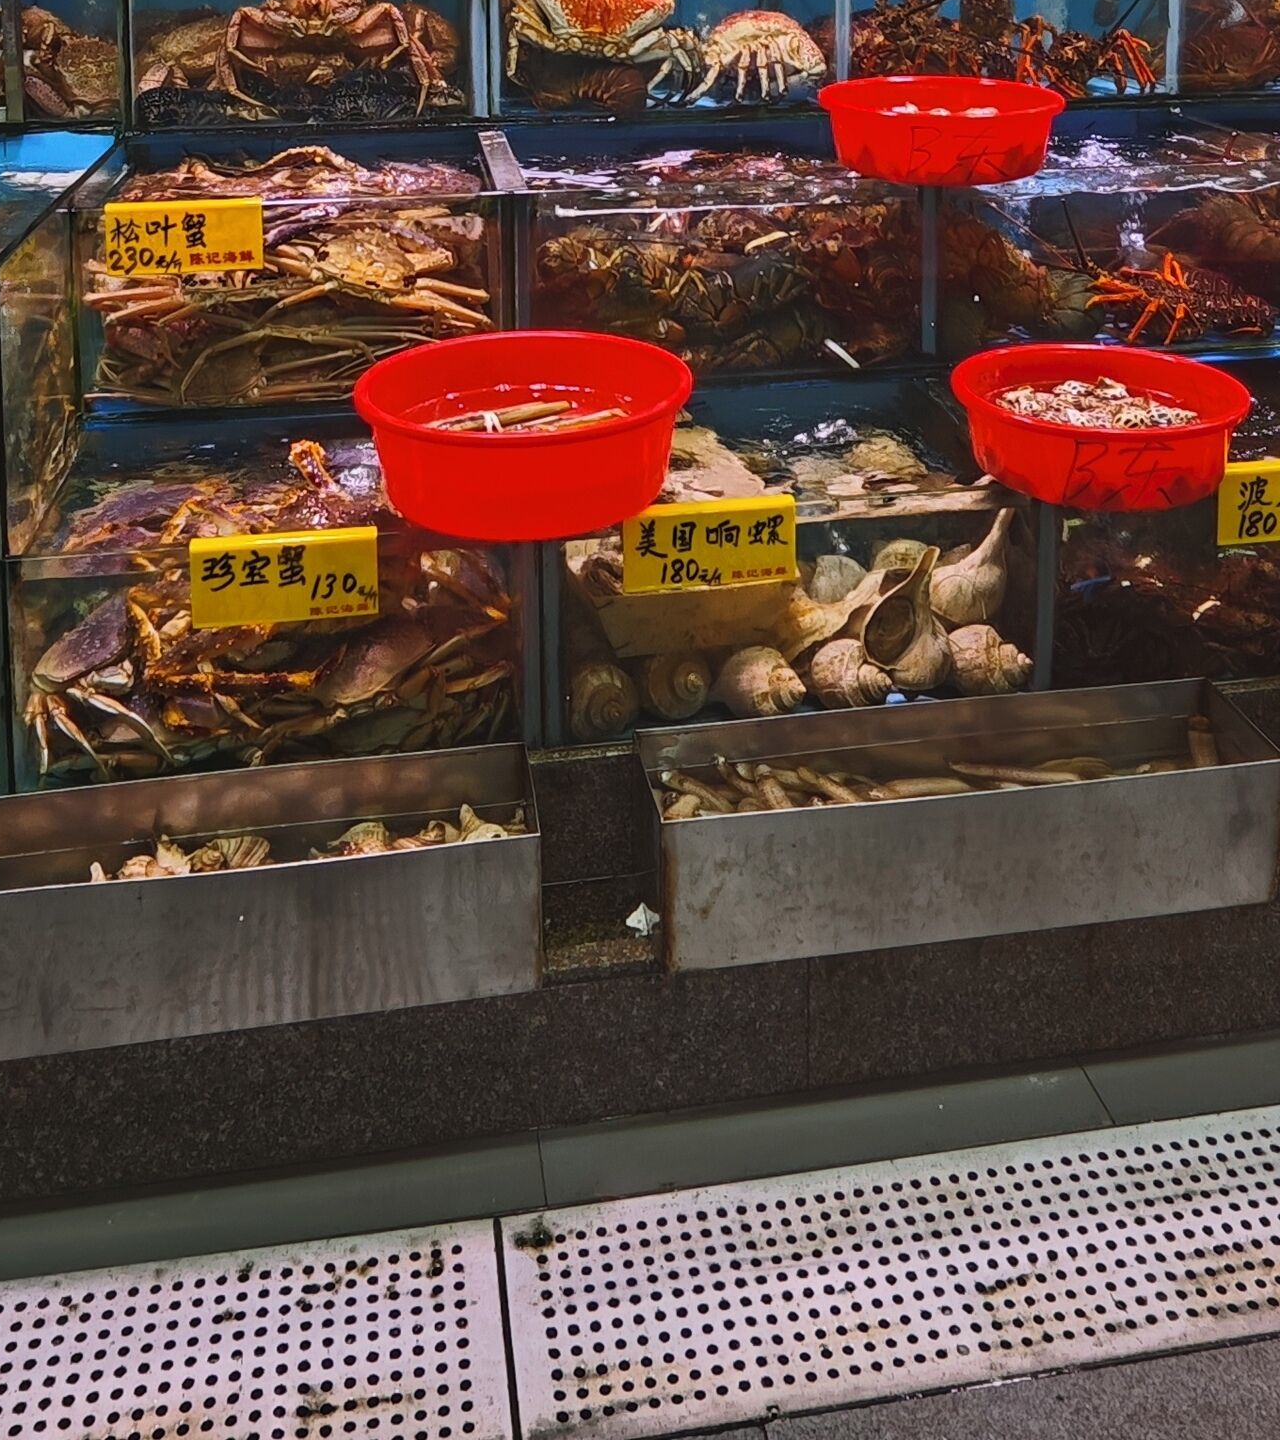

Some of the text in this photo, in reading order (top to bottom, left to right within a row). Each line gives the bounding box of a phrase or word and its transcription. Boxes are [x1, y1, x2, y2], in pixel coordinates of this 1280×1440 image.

[110, 211, 207, 249] 松叶蟹
[189, 250, 256, 266] 陈记海鲜
[635, 514, 788, 558] 美国响螺
[201, 545, 307, 592] 珍宝蟹
